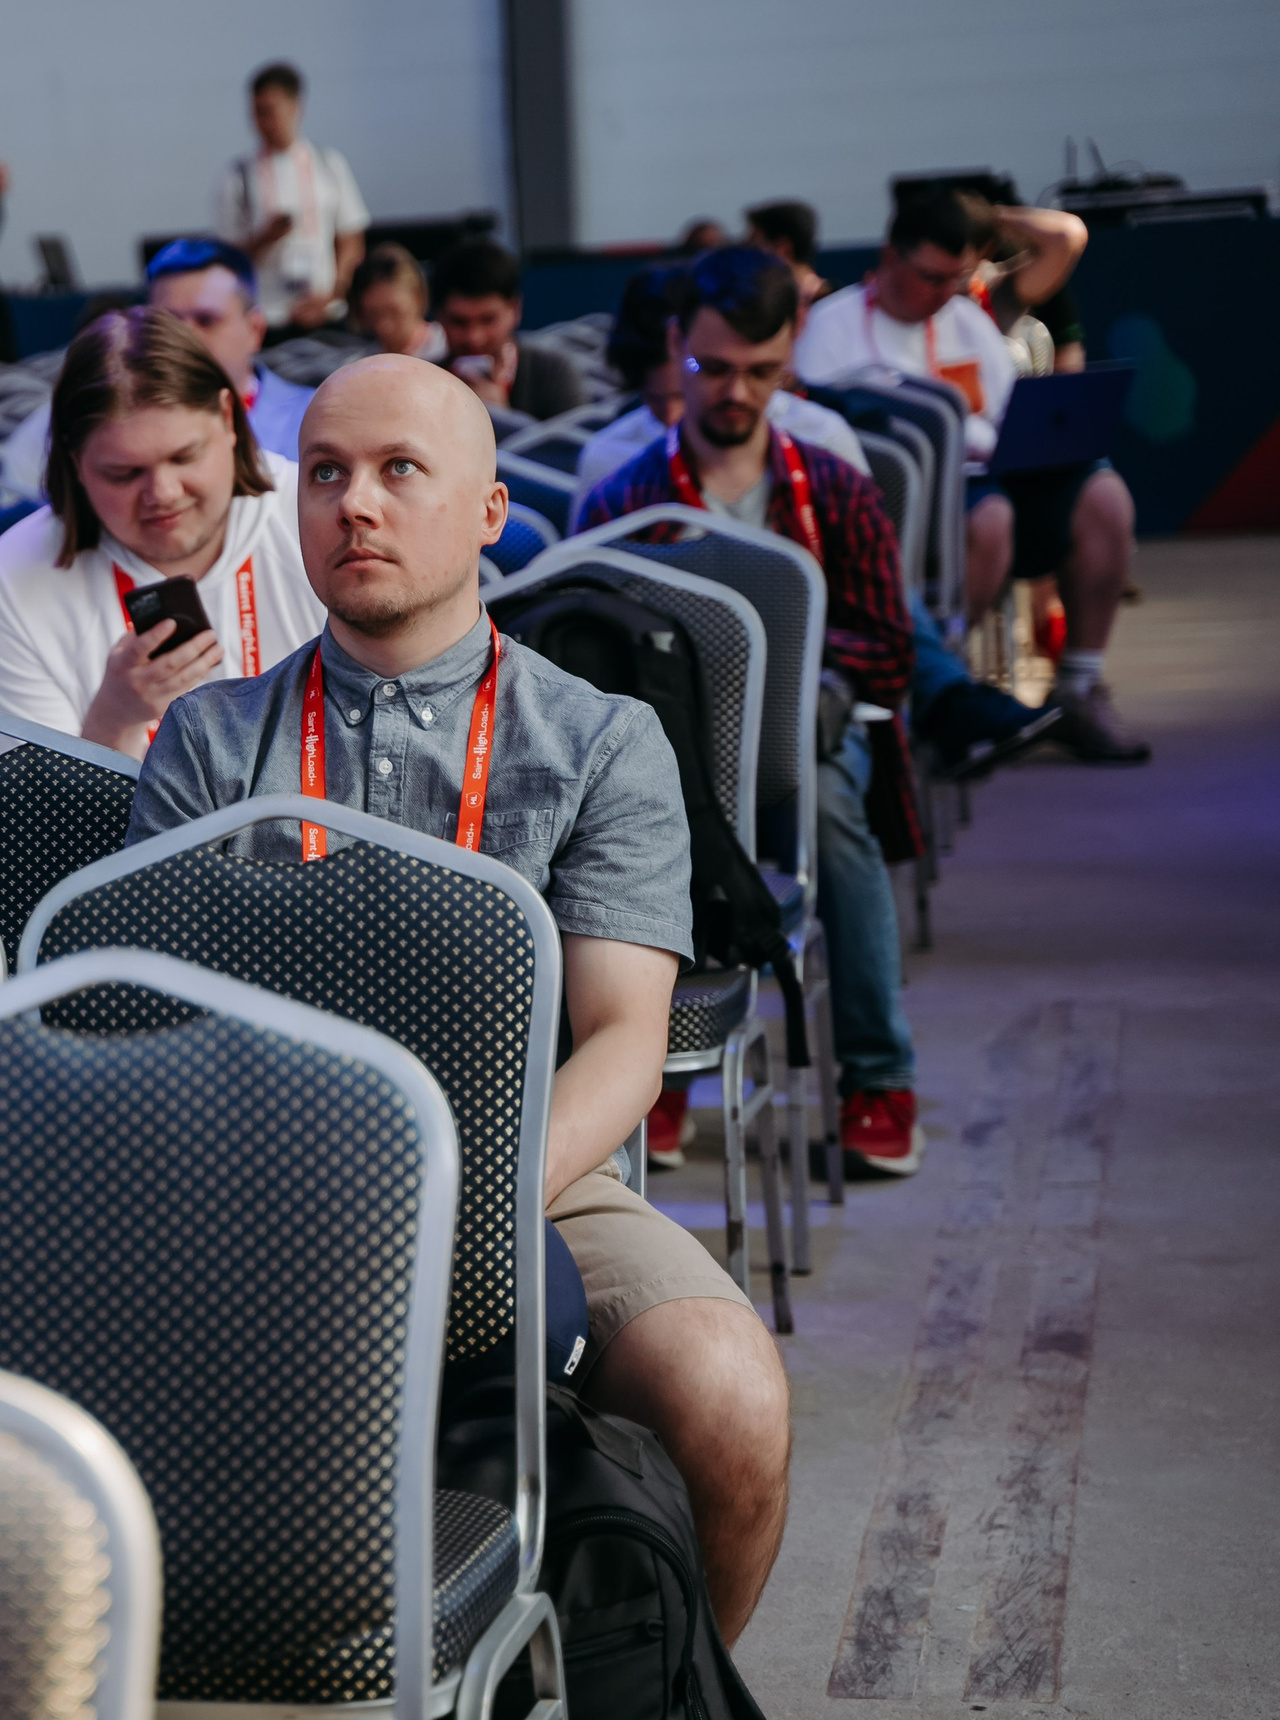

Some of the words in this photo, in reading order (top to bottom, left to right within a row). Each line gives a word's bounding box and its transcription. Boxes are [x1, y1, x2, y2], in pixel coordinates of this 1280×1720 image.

[307, 711, 317, 733] Saint
[473, 703, 489, 755] HighLoad++
[305, 734, 319, 787] HighLoad++
[472, 756, 484, 780] Saint
[309, 828, 318, 851] Saint
